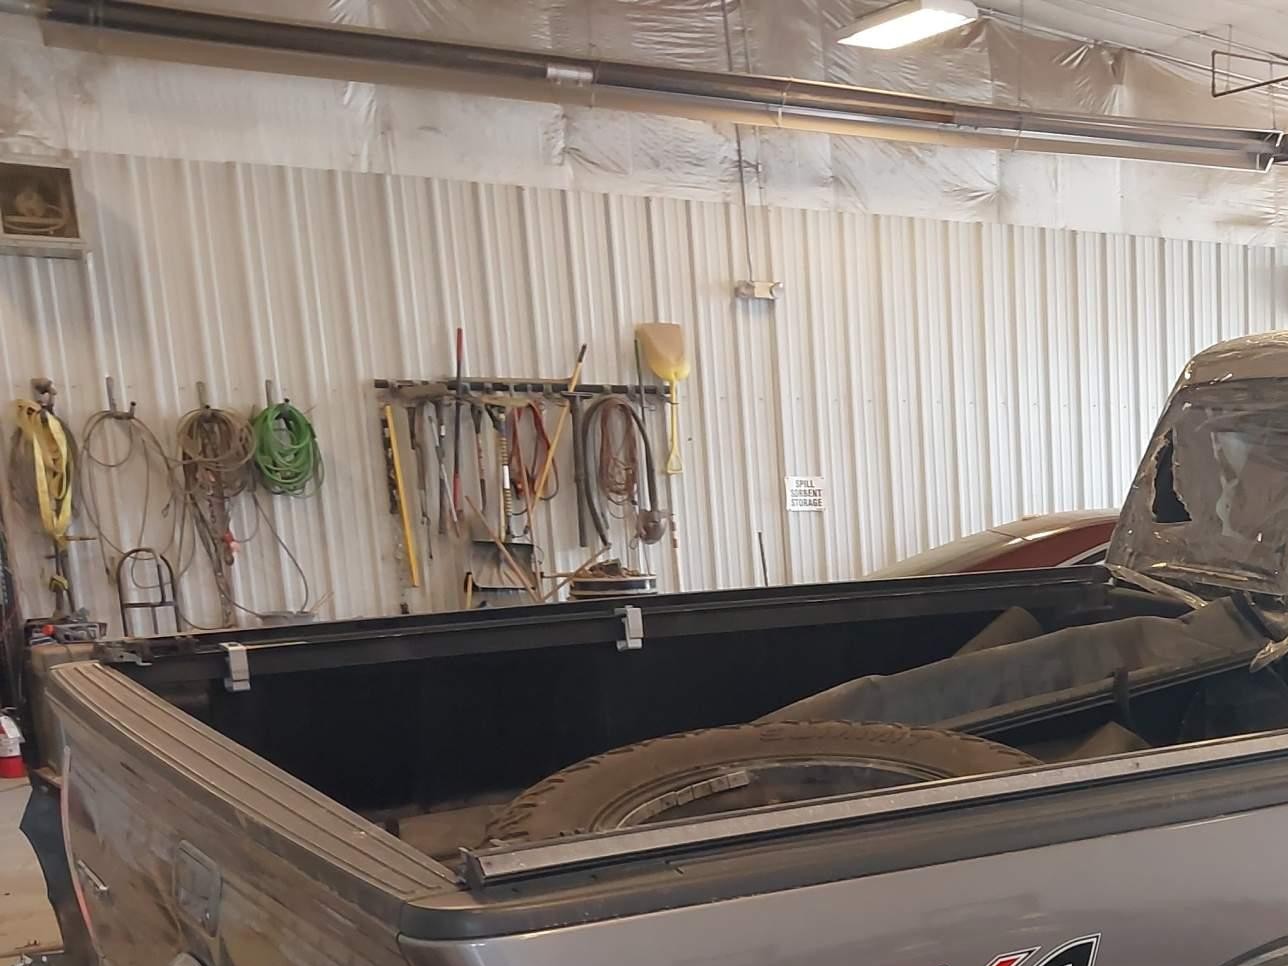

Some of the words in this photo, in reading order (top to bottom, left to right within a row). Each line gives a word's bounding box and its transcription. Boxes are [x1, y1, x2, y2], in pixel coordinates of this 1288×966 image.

[795, 480, 815, 488] SPILL
[790, 489, 823, 498] SORBENT
[791, 498, 823, 507] STORAGE
